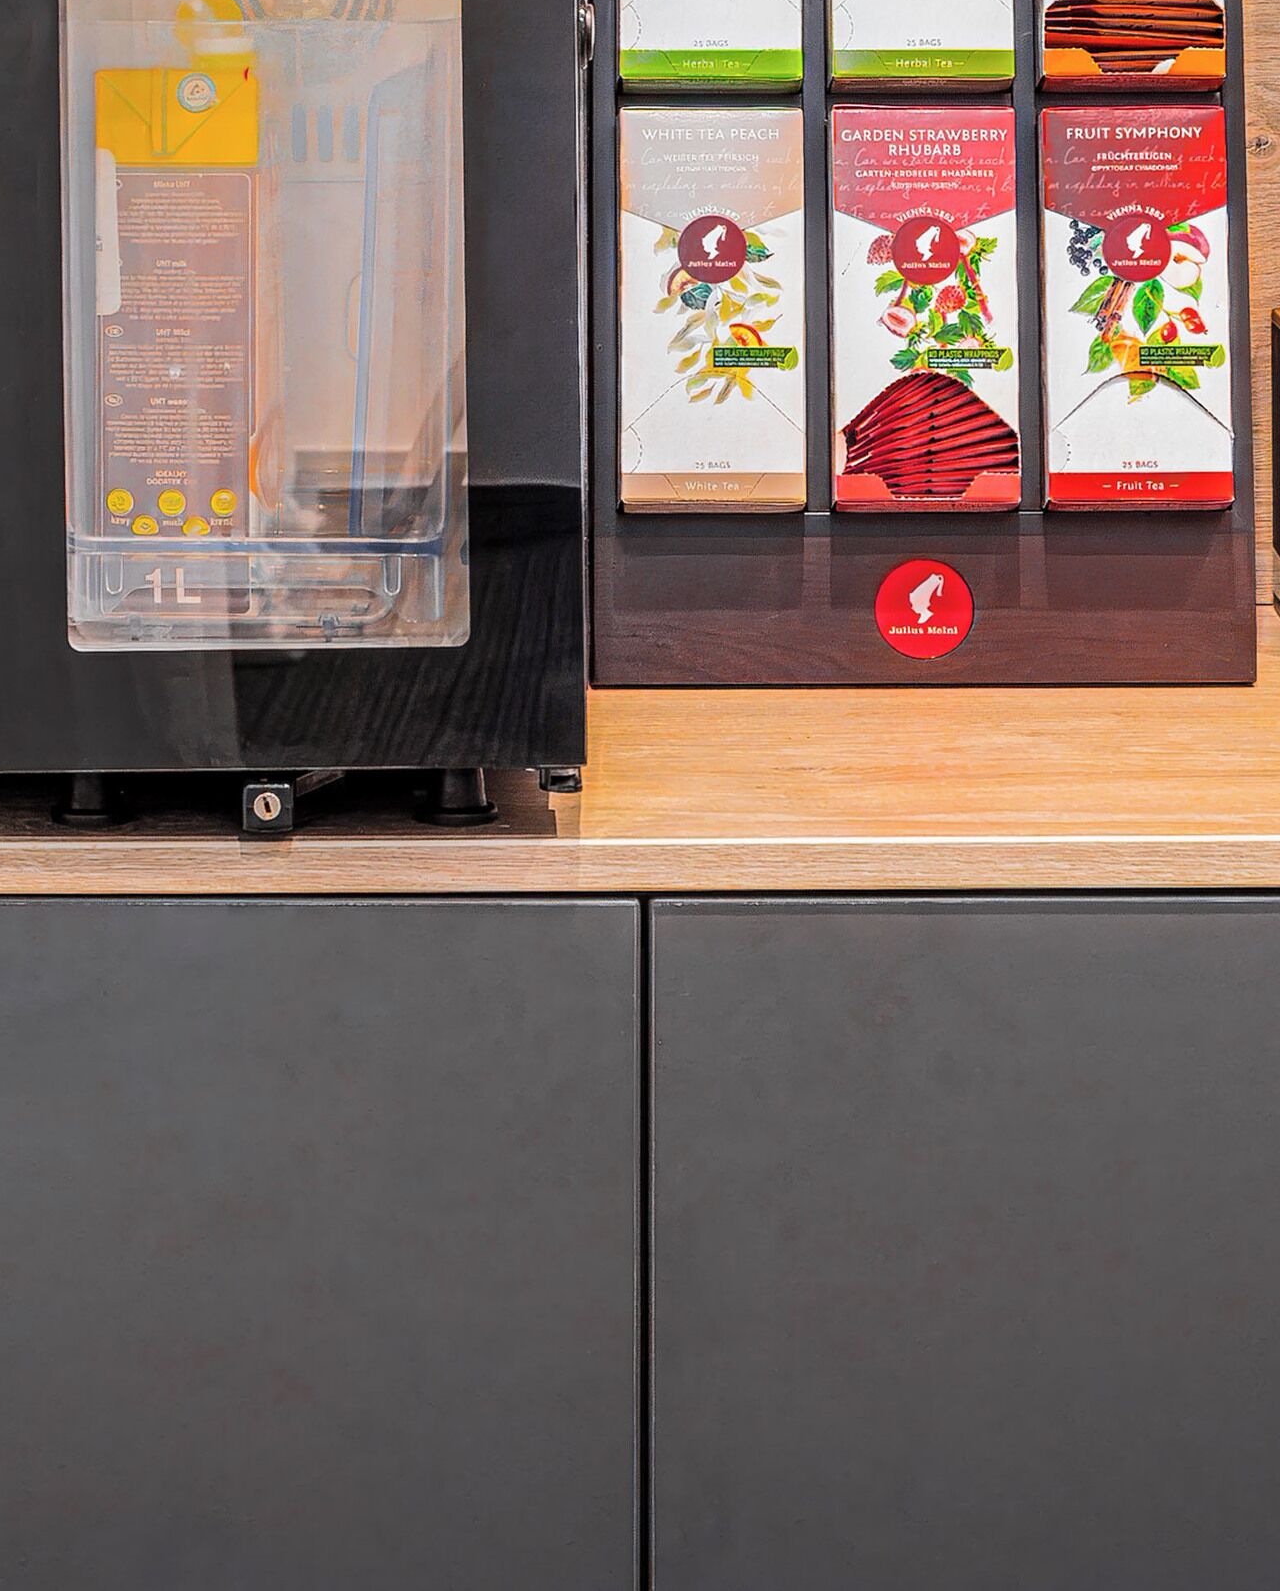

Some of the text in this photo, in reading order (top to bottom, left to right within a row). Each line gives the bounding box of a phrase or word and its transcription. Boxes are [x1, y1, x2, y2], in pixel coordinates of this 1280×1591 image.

[919, 38, 942, 46] BAGS
[683, 59, 740, 68] Herbal Tea
[895, 58, 953, 67] Herbal Tea
[642, 129, 779, 140] WHITE TEA PEACH
[841, 129, 1008, 141] GARDEN STRAWBERRY
[1066, 127, 1202, 140] FRUIT SYMPHONY
[889, 145, 961, 156] RHUBARB
[896, 207, 932, 223] VIENNA
[1107, 204, 1143, 221] VIENNA
[724, 348, 749, 357] PLASTIC
[938, 350, 963, 358] PLASTIC
[1150, 347, 1175, 356] PLASTIC
[708, 461, 731, 469] BAGS
[685, 481, 739, 490] White Tea
[1116, 481, 1164, 490] Fruit Tea
[889, 626, 958, 634] Julius Meinl
